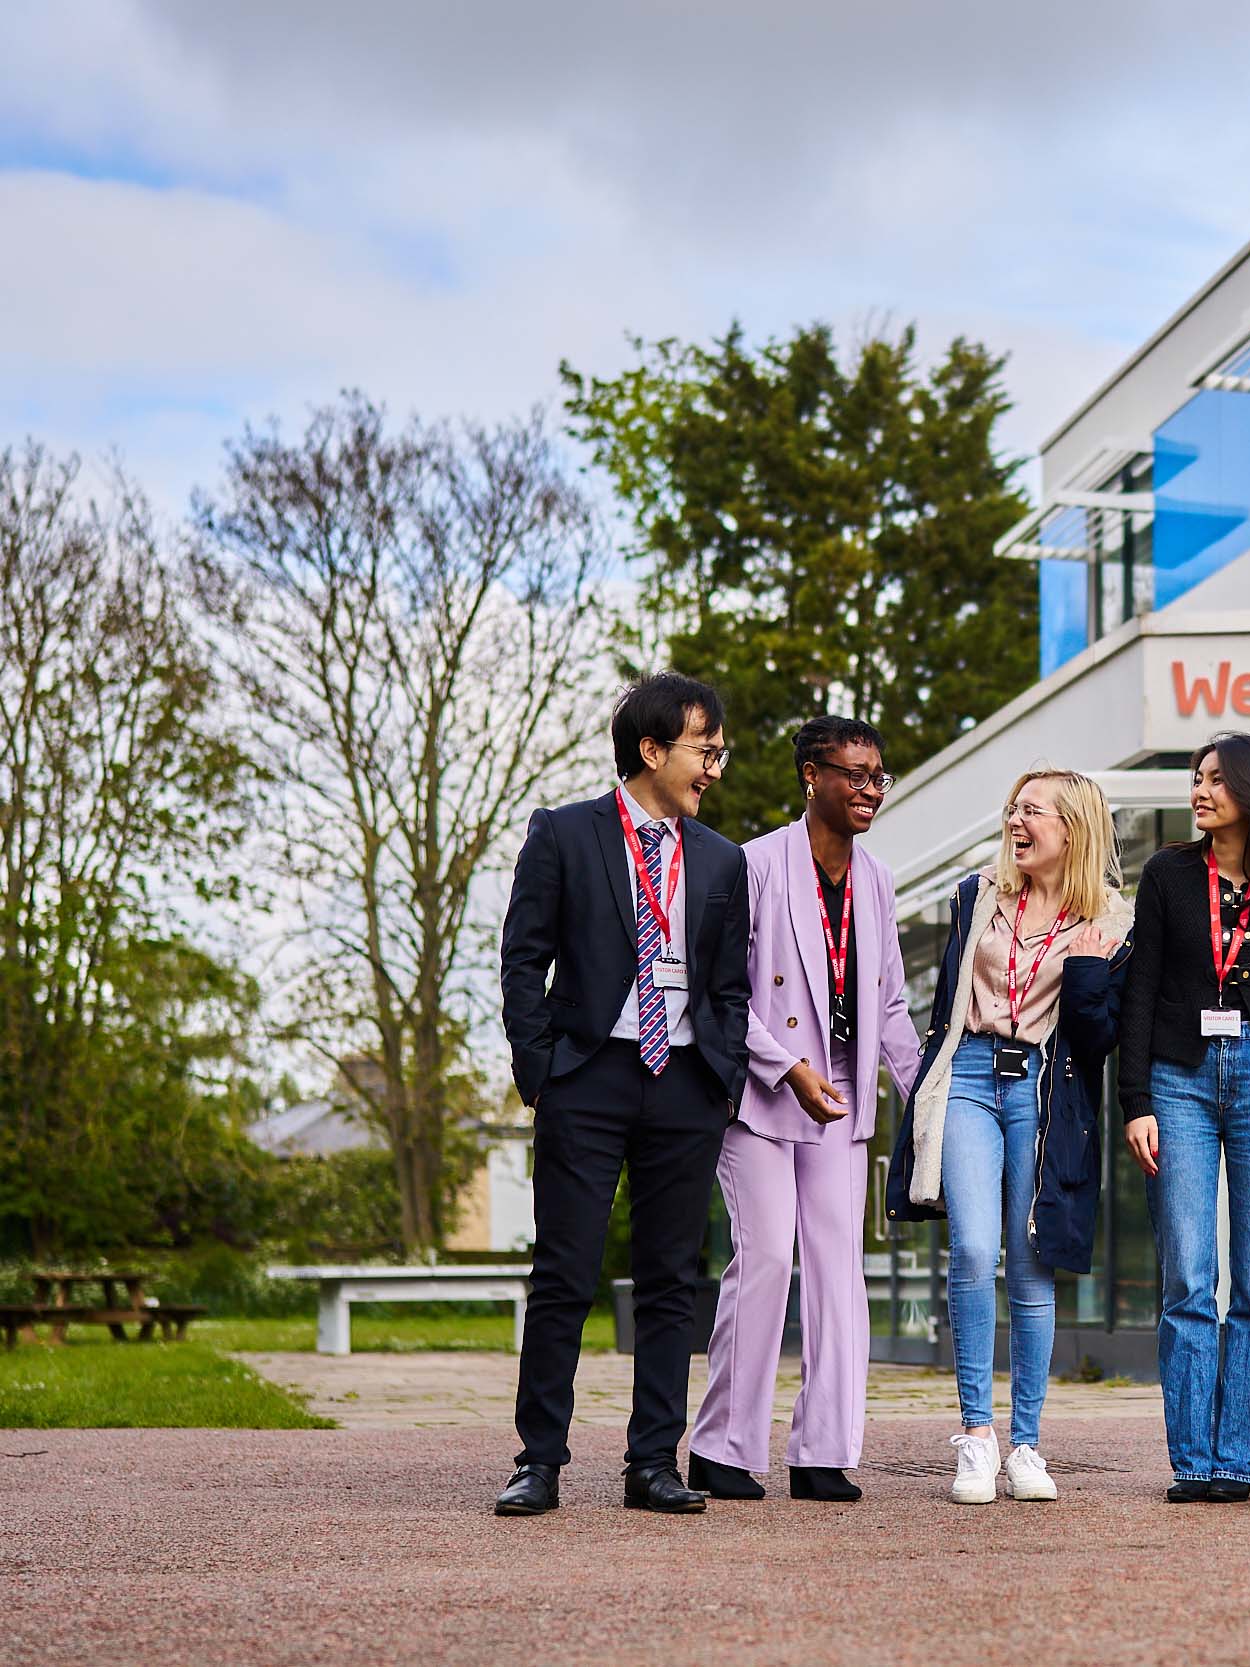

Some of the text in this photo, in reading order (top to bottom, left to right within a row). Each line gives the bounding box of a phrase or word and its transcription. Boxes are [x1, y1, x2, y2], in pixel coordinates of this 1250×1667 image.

[840, 927, 848, 948] VISITOR
[1051, 919, 1063, 937] VISITOR
[825, 928, 835, 950] VISITOR
[1036, 944, 1050, 962] VISITOR
[832, 958, 841, 980] VISITOR
[1024, 971, 1036, 991] VISITOR
